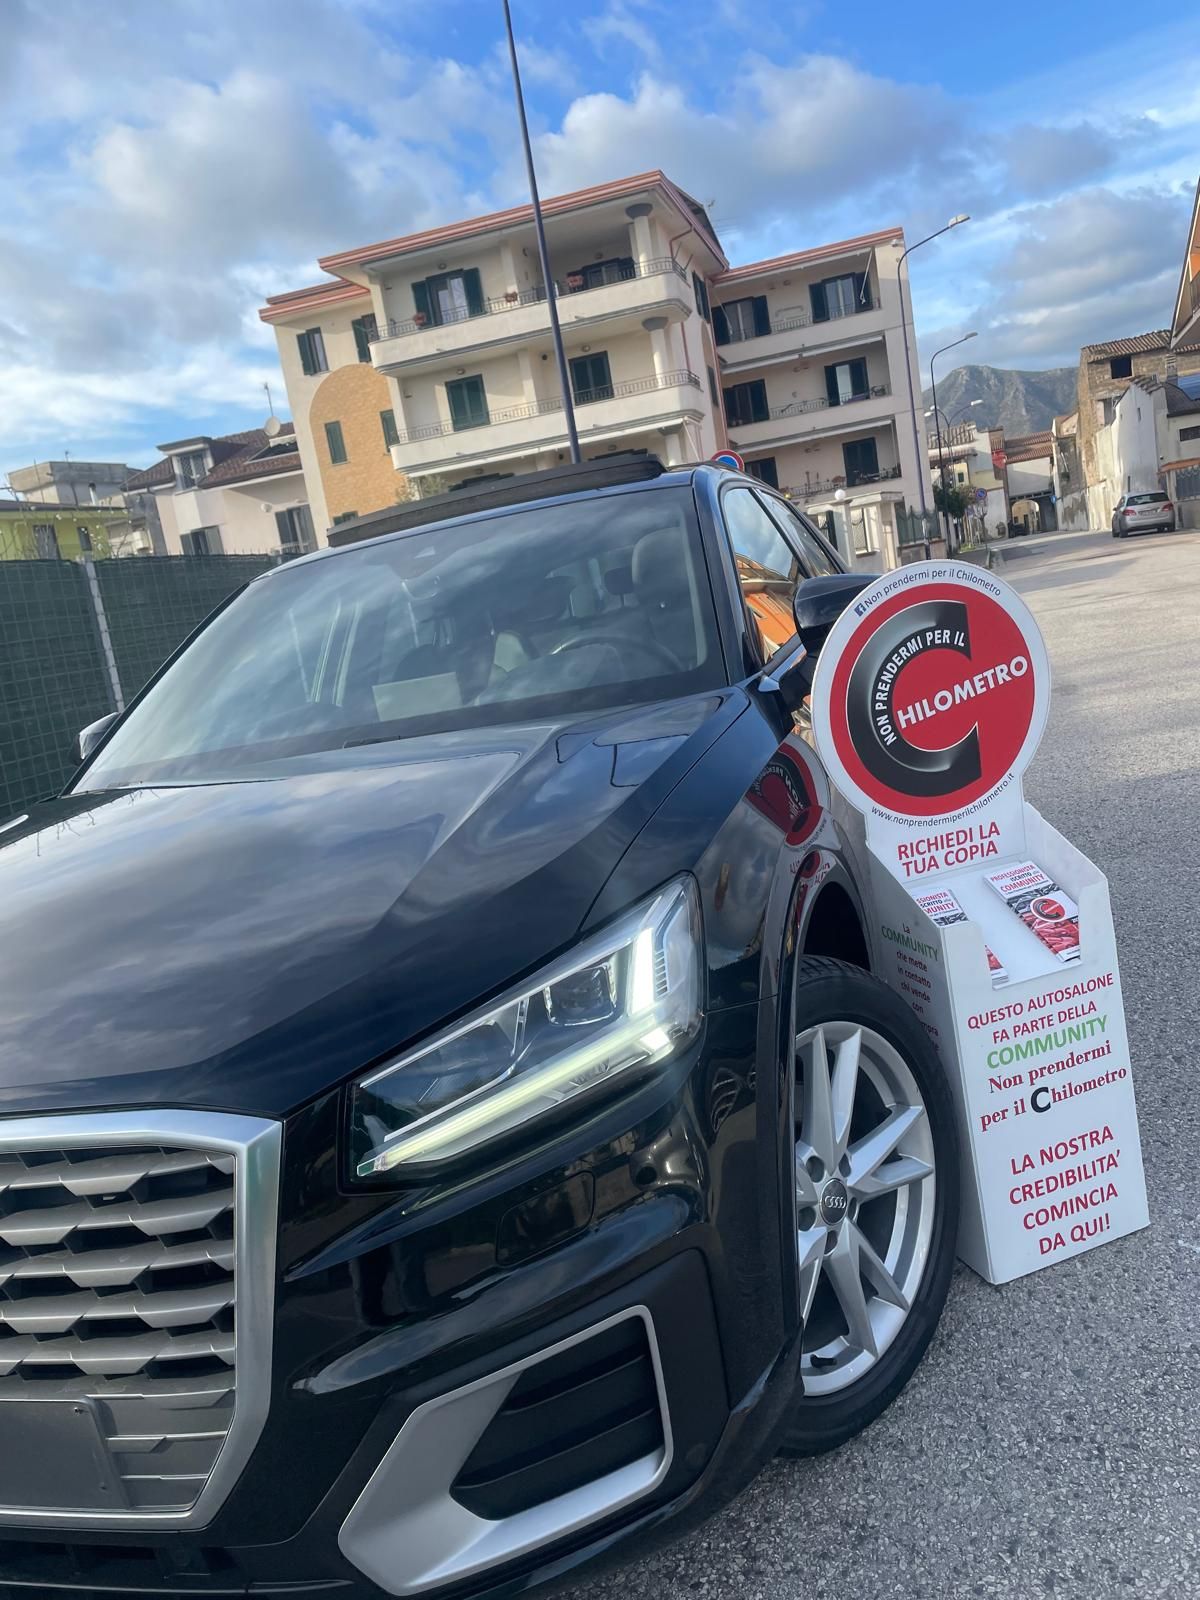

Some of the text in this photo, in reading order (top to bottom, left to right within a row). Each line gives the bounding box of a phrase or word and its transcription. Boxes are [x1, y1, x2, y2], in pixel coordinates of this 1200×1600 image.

[865, 569, 1001, 608] Non prendermi per il Chilometro
[875, 629, 965, 746] NON PRENDERMI PER IL
[871, 772, 1015, 828] www.nonprendermiperilchilometro.it
[897, 821, 1001, 861] RICHIEDI LA
[902, 840, 999, 877] TUA COPIA
[1000, 873, 1045, 892] COMMUNITY
[881, 925, 939, 962] COMMUNITY
[967, 973, 1114, 1029] QUESTO AUTOSALONE
[993, 1000, 1097, 1044] FA PARTE DELLA
[986, 1014, 1108, 1069] COMMUNITY
[988, 1040, 1112, 1094] Non prendermi
[980, 1067, 1127, 1132] per il Chilometro
[1011, 1125, 1114, 1175] LA NOSTRA
[1023, 1183, 1118, 1230] COMINCIA
[1039, 1213, 1111, 1255] DA QUI!
